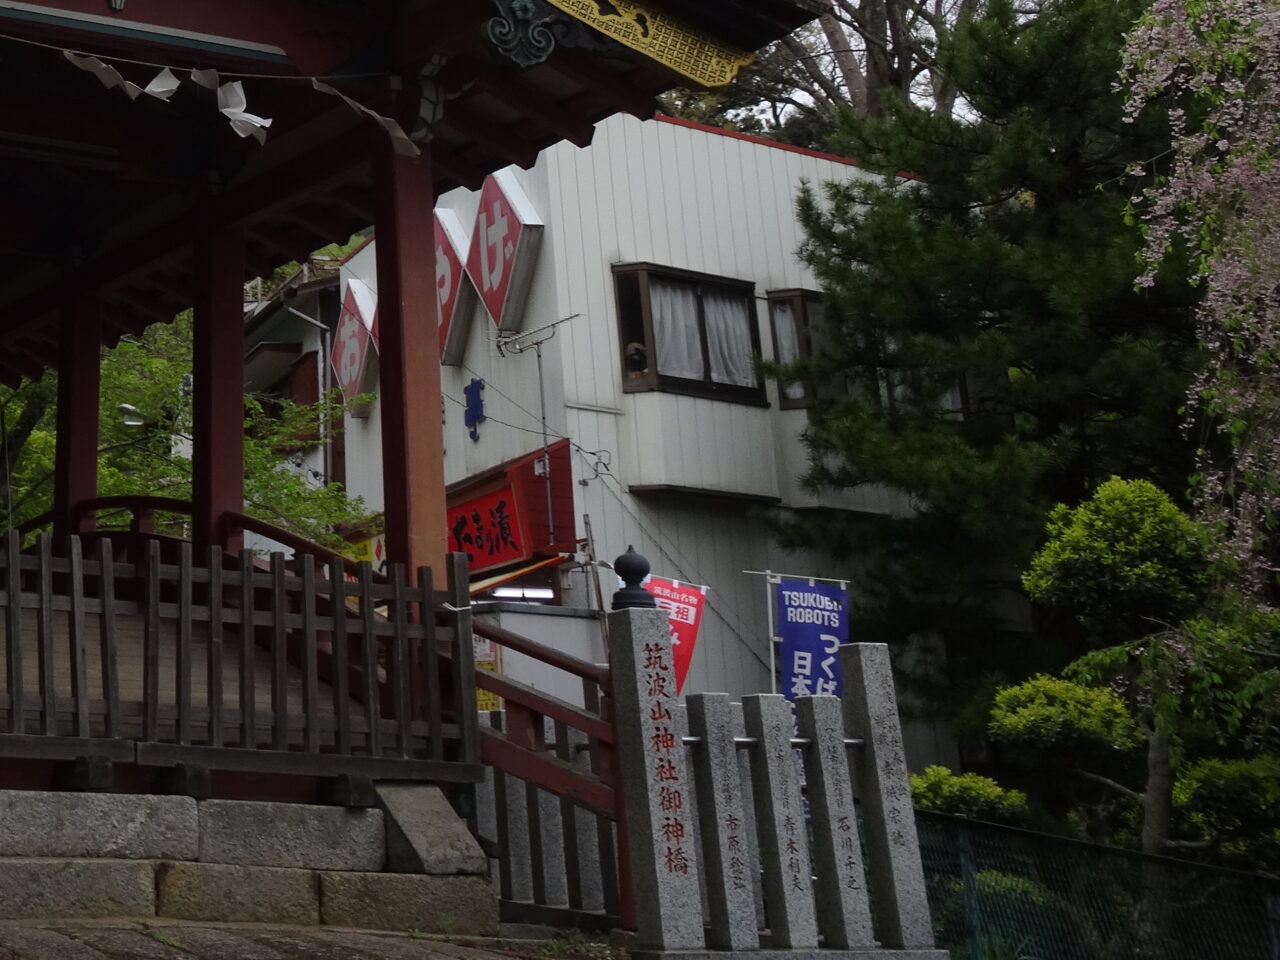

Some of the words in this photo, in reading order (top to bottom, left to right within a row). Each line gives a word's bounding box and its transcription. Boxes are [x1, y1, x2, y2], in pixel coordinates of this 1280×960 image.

[787, 607, 840, 628] ROBOTS
[816, 633, 841, 696] つくば
[642, 642, 688, 875] 筑波山神社御神橋
